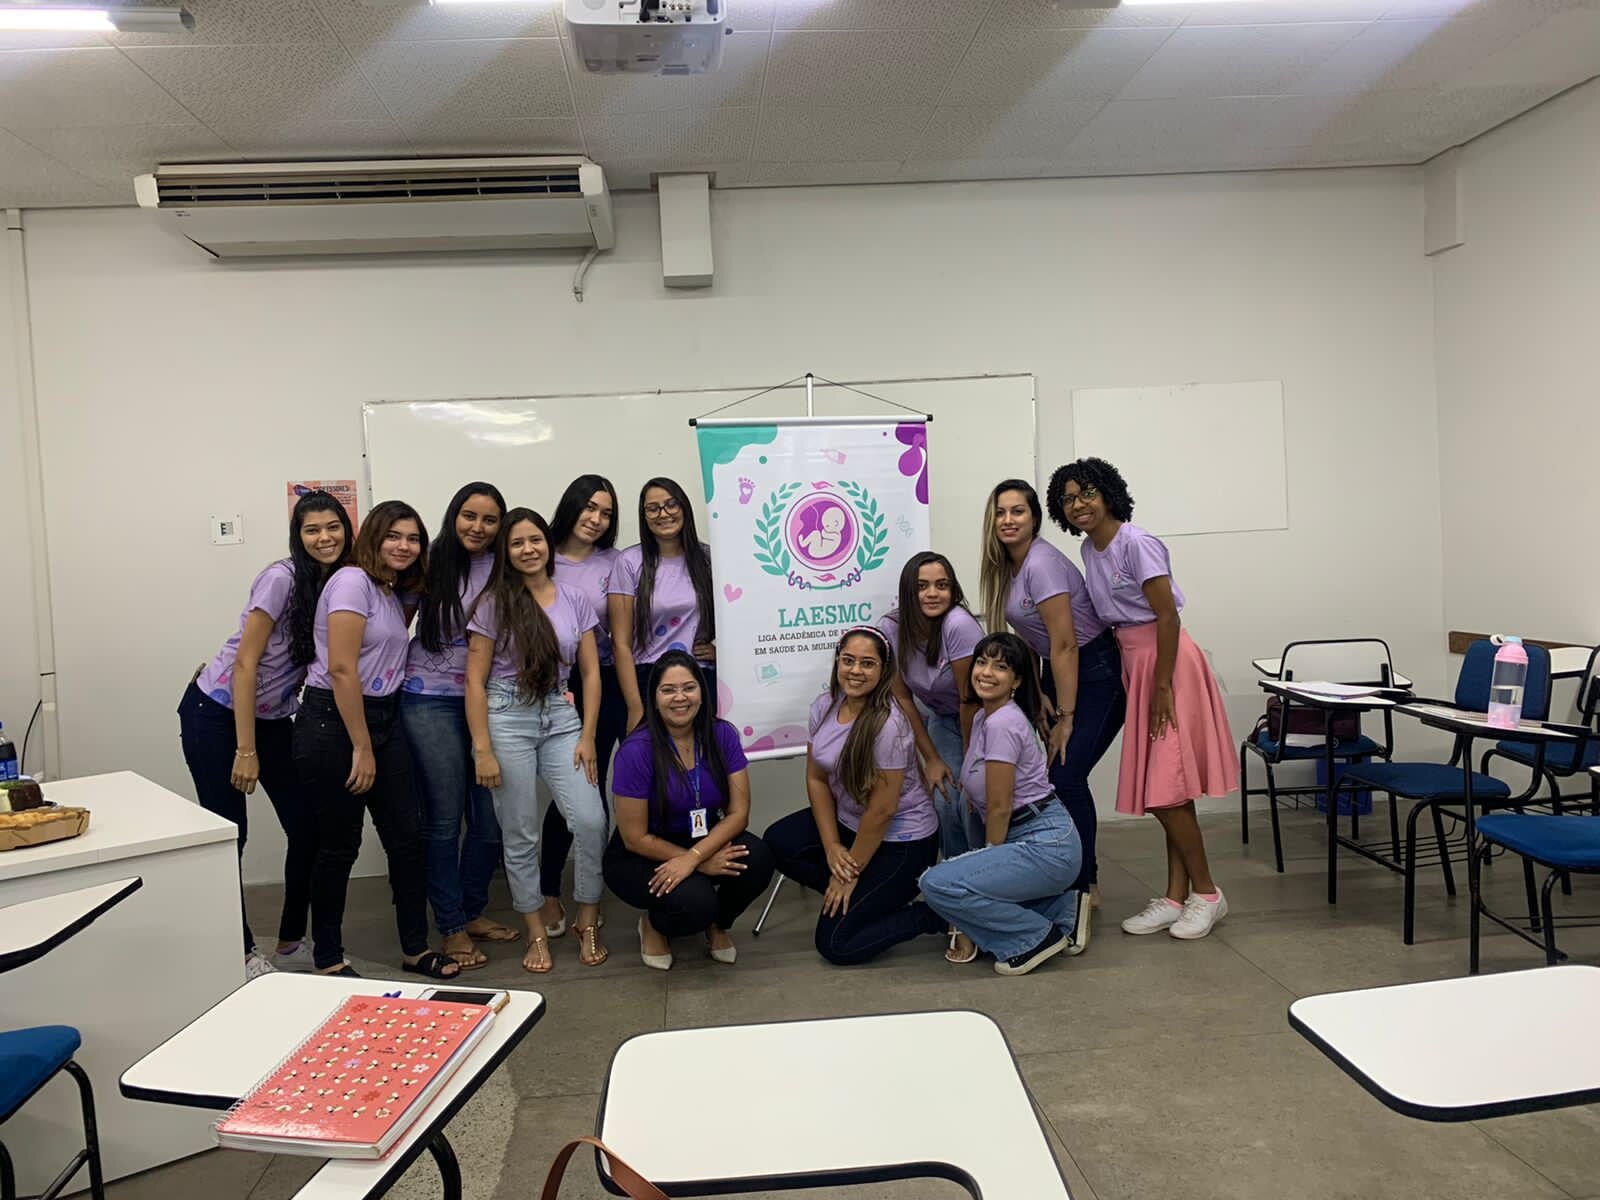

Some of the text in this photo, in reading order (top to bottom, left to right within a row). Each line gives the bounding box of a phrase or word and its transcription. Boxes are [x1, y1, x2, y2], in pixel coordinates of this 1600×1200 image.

[778, 602, 872, 628] LAESMC
[758, 633, 777, 642] LIGA
[779, 630, 826, 641] ACADÊMICA
[828, 629, 838, 637] DE
[754, 641, 840, 655] EM SAÚDE DA MULHE
